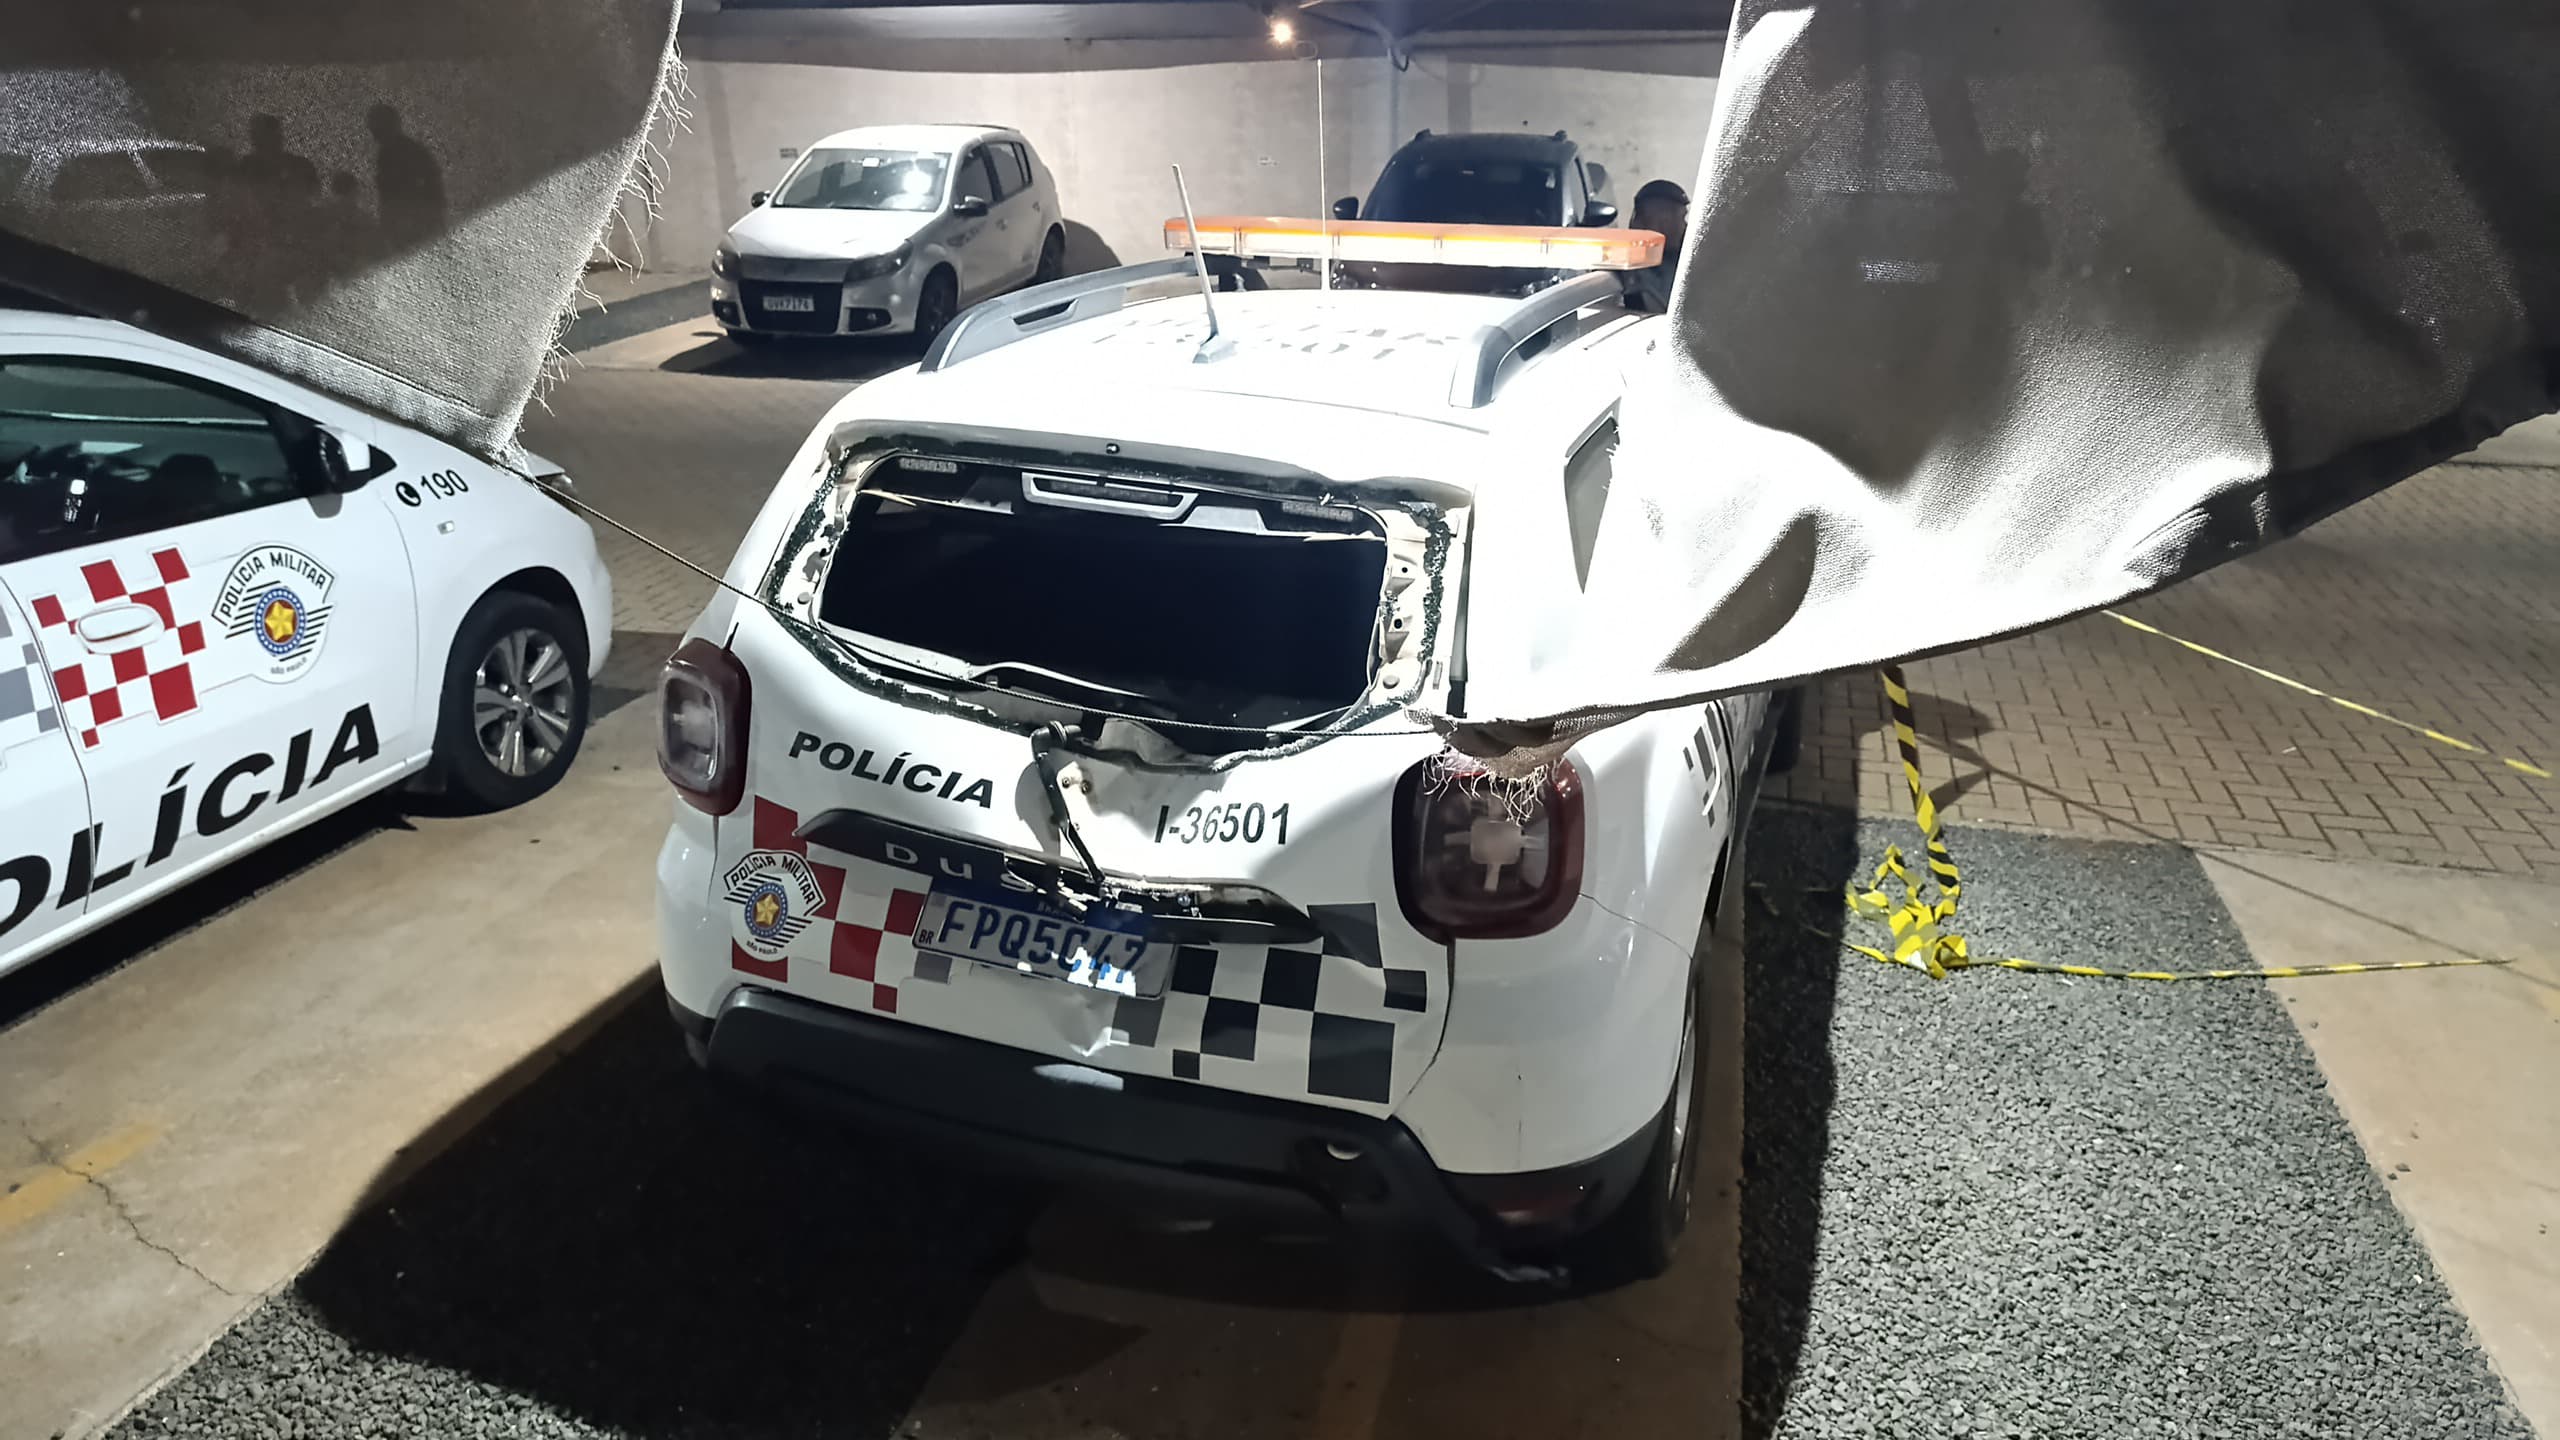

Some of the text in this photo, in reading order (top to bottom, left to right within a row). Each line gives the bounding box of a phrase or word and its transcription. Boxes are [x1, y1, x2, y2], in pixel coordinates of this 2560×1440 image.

[421, 468, 469, 500] 190
[219, 551, 326, 618] POLÍCIA MILITAR
[788, 730, 993, 809] POLÍCIA
[1154, 802, 1290, 845] I-36501
[730, 855, 816, 905] POLÍCIA MILITAR
[919, 929, 935, 945] BR
